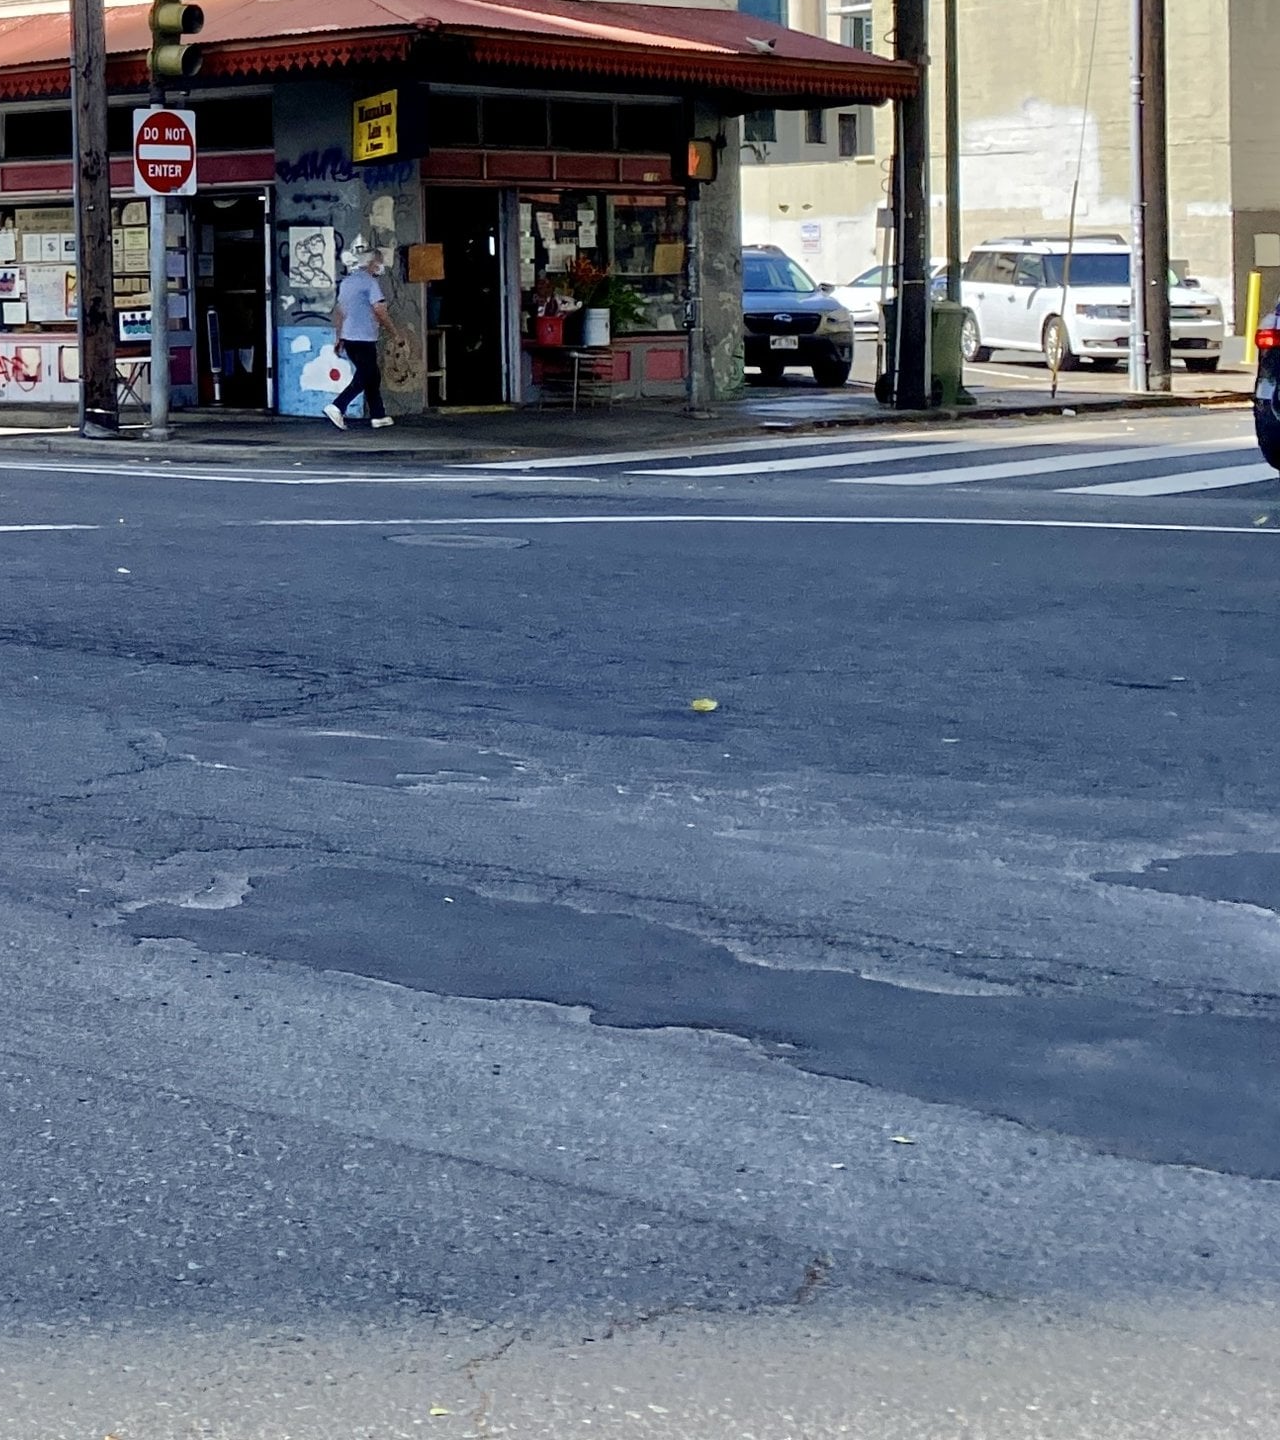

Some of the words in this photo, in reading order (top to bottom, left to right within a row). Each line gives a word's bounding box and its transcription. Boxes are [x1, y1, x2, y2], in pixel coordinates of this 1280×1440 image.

[144, 127, 159, 141] DO
[165, 127, 186, 141] NOT
[148, 164, 182, 177] ENTER
